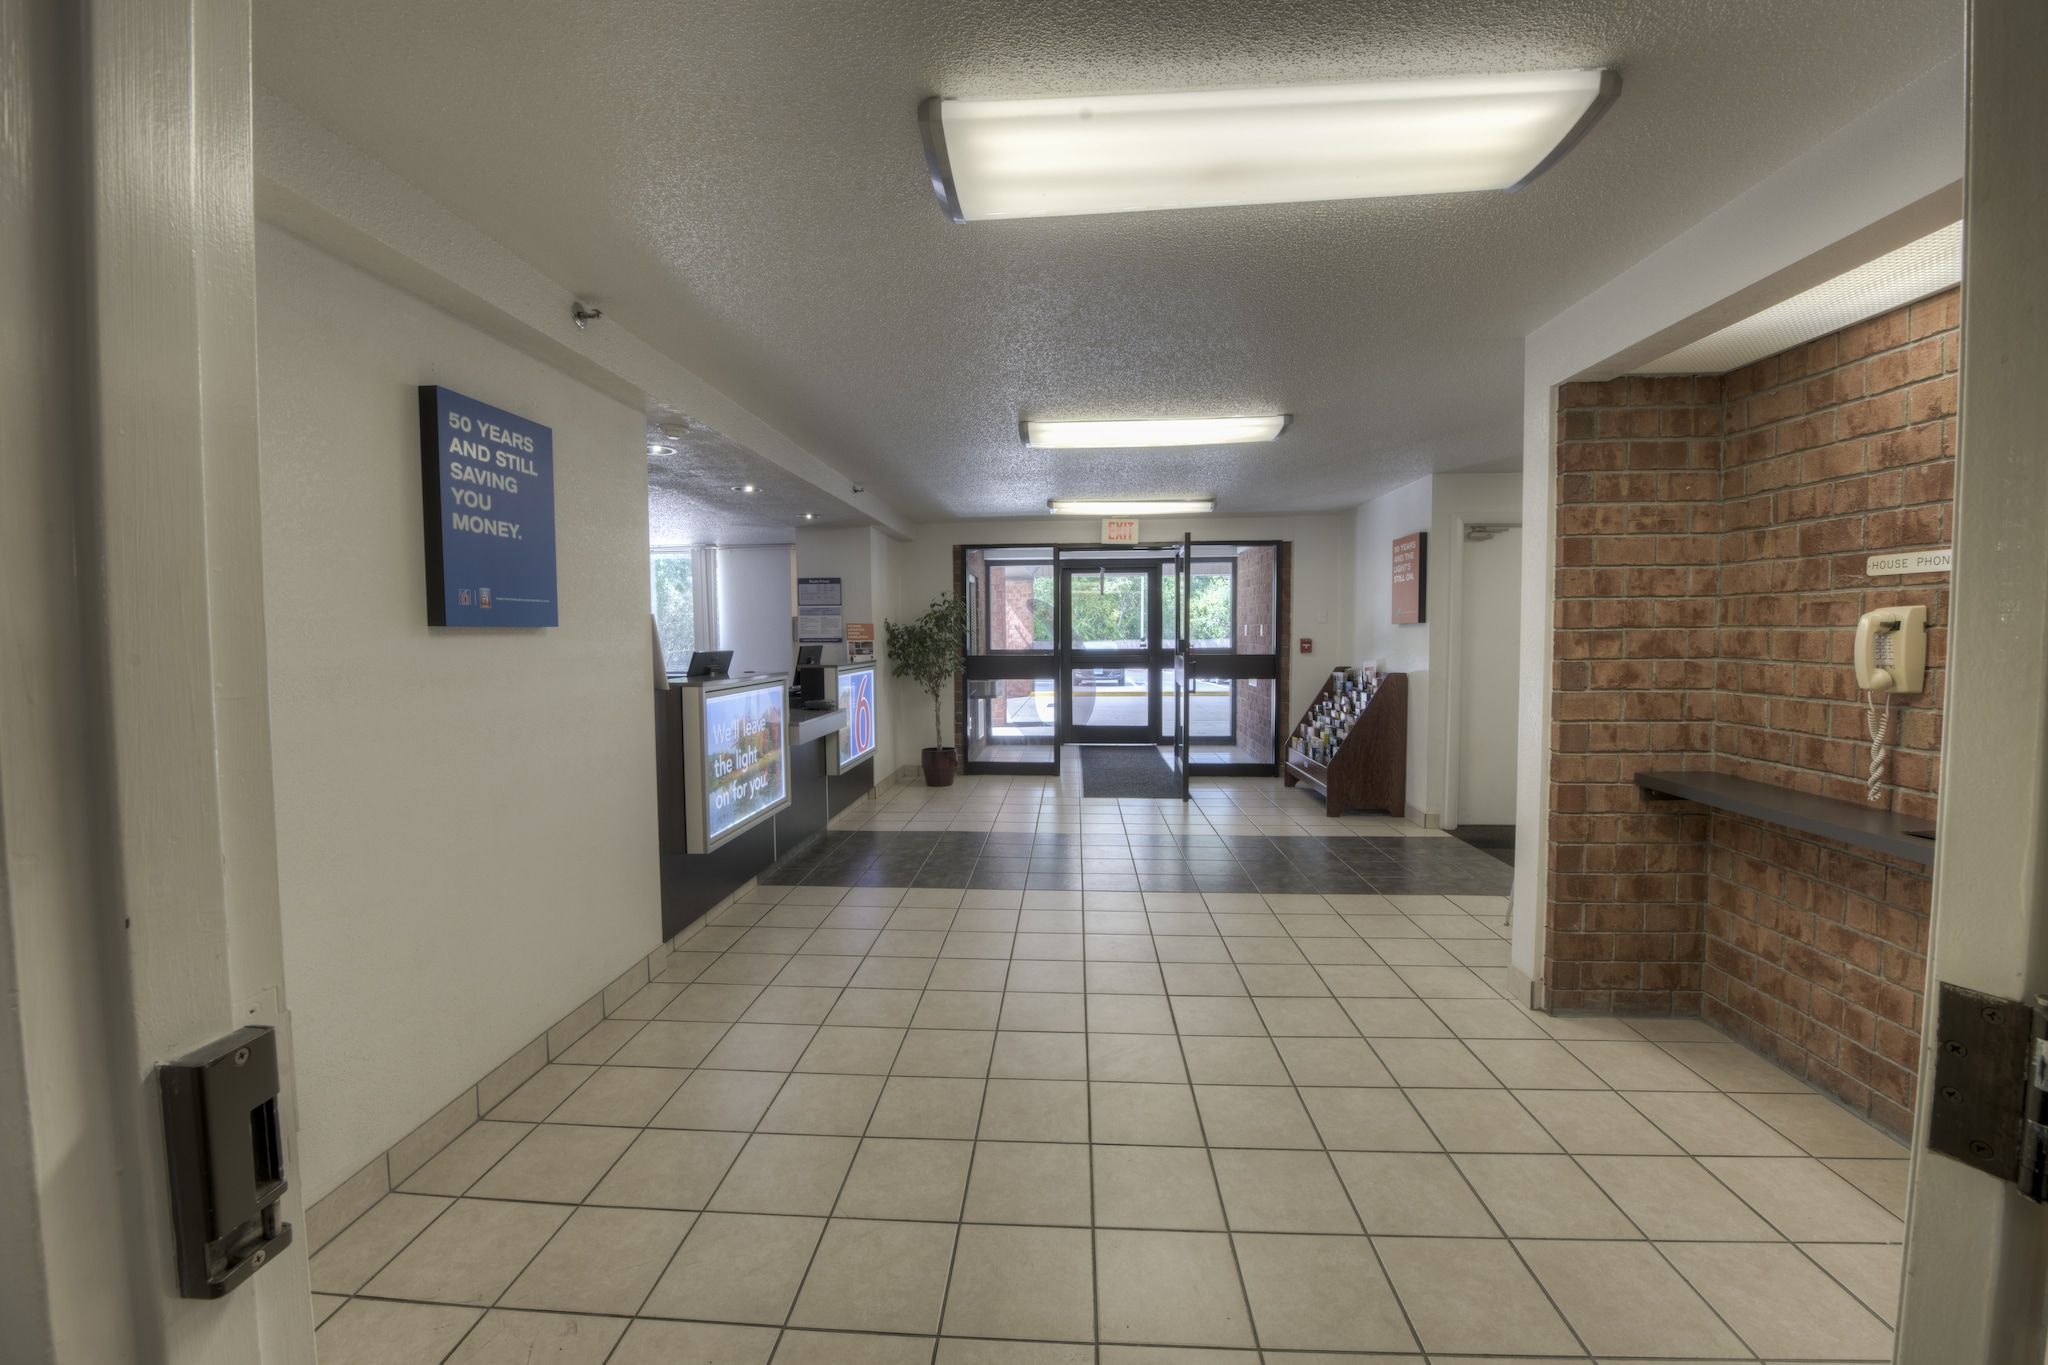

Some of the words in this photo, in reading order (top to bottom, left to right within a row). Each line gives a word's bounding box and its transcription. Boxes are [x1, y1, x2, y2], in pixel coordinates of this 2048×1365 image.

[448, 412, 472, 433] 50
[476, 419, 535, 453] YEARS
[449, 437, 491, 463] AND
[495, 450, 539, 477] STILL
[450, 461, 519, 494] SAVING
[450, 486, 492, 511] YOU
[452, 512, 523, 540] MONEY.
[1108, 521, 1135, 540] EXIT
[1872, 558, 1909, 570] HOUSE
[1917, 555, 1951, 566] PHON
[855, 674, 870, 754] 6
[713, 719, 740, 745] We'll
[742, 717, 766, 736] leave
[714, 754, 733, 778] the
[735, 745, 758, 773] light
[715, 790, 730, 809] on
[732, 780, 747, 801] for
